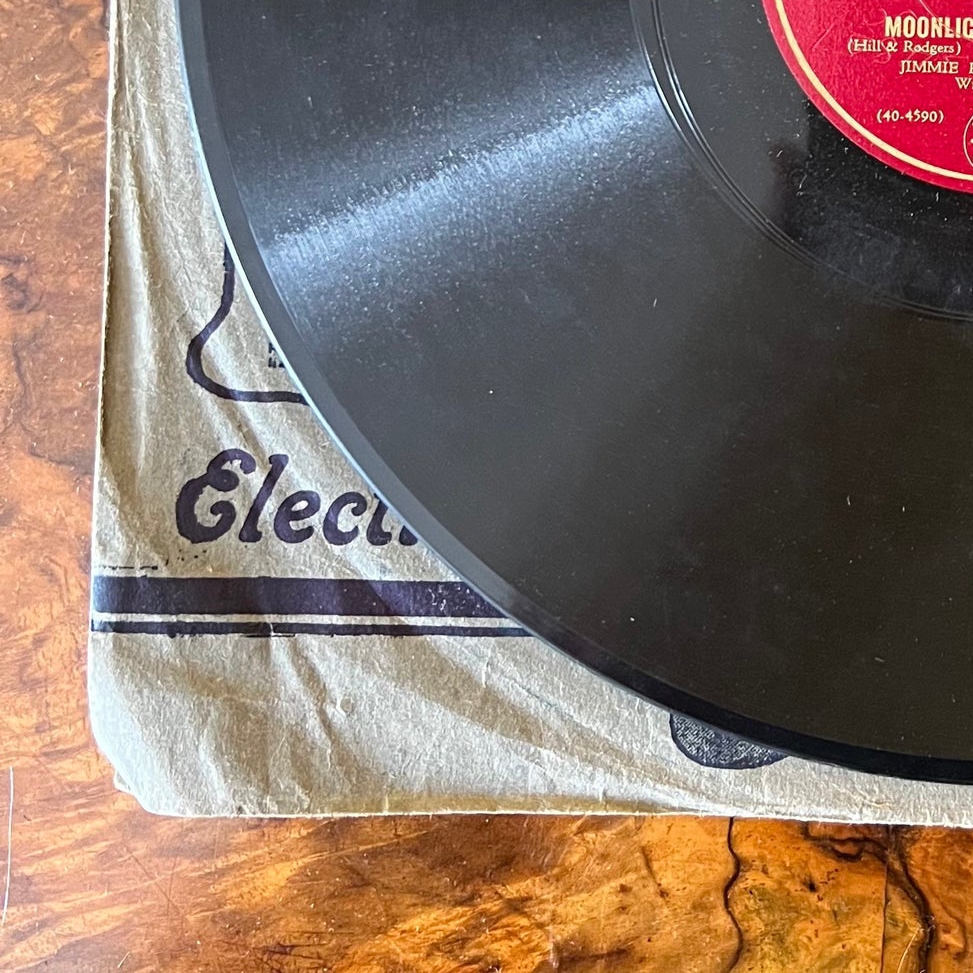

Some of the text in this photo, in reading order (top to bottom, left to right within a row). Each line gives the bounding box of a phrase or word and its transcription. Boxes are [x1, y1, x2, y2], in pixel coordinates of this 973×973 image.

[848, 39, 961, 55] (Hill & Rodgers)
[900, 60, 958, 74] JIMMIE
[877, 109, 943, 123] (40-4590)
